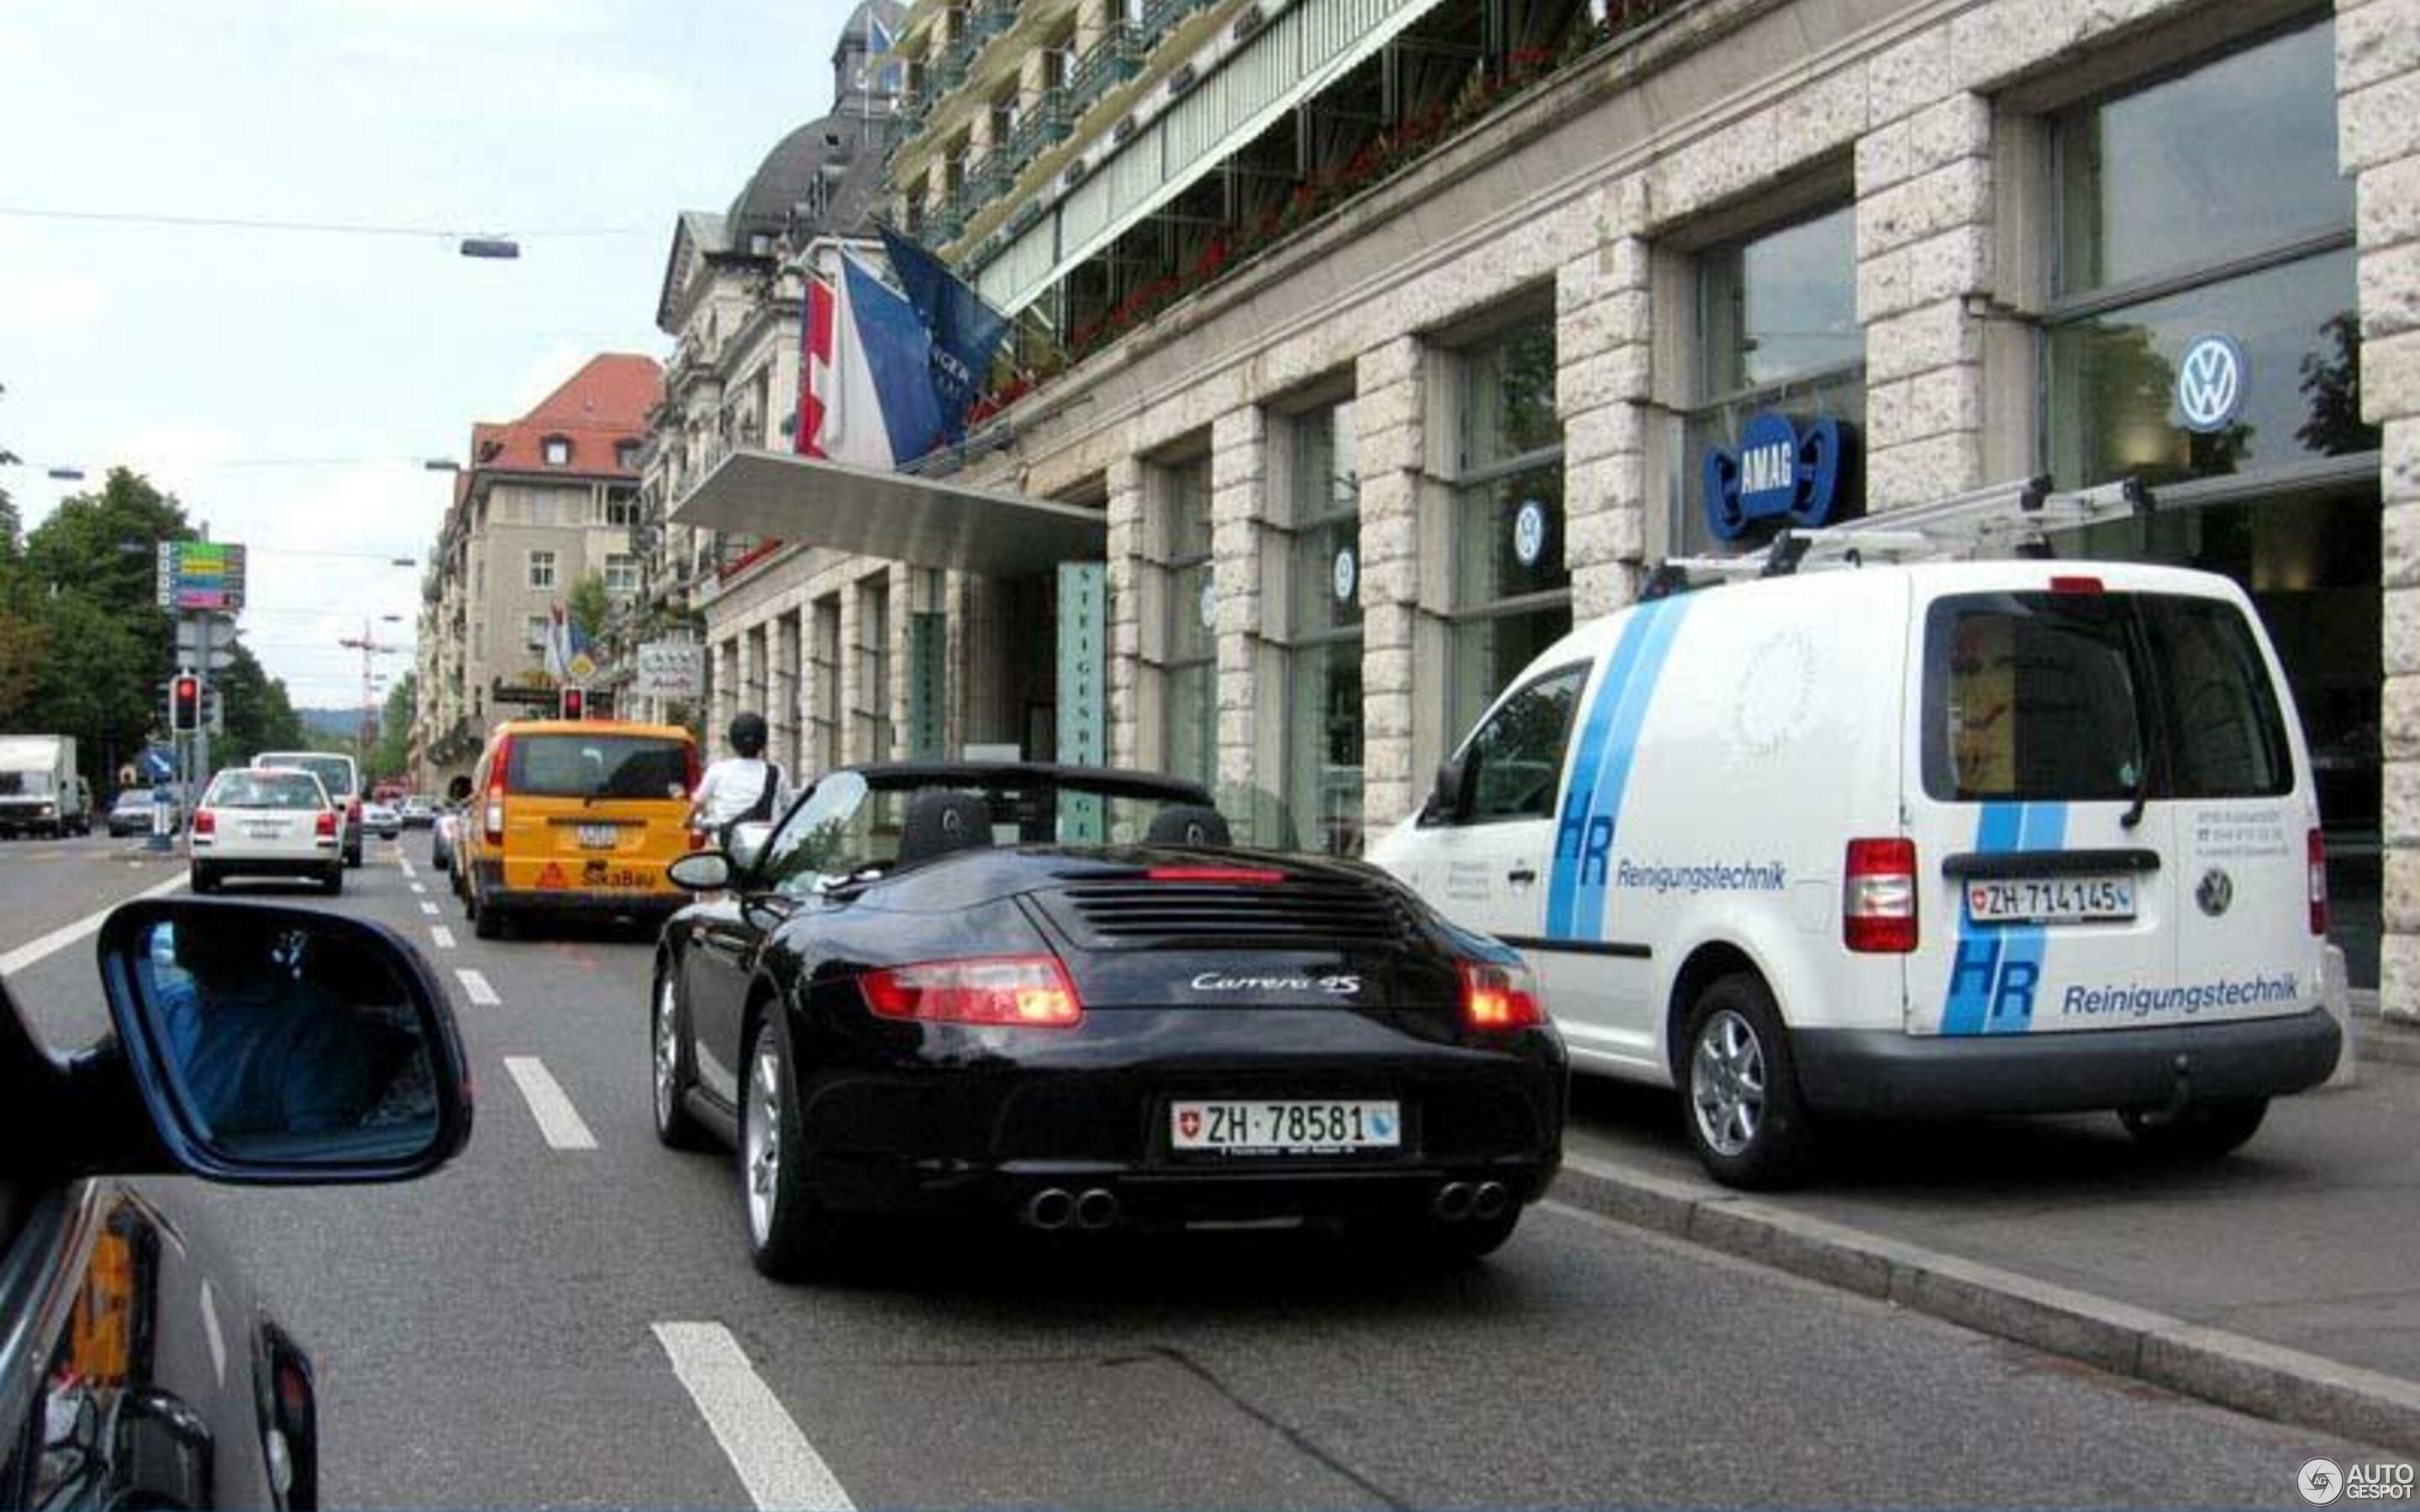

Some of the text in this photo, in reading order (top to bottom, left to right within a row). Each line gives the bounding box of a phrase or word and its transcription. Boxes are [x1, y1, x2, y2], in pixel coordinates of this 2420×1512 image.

[1741, 440, 1792, 494] AMAG
[1556, 792, 1616, 885] HR
[1618, 857, 1785, 894] Reinigungstechnik
[1191, 972, 1316, 990] Carrera
[1949, 939, 2299, 1017] HR Reinigungstechnik
